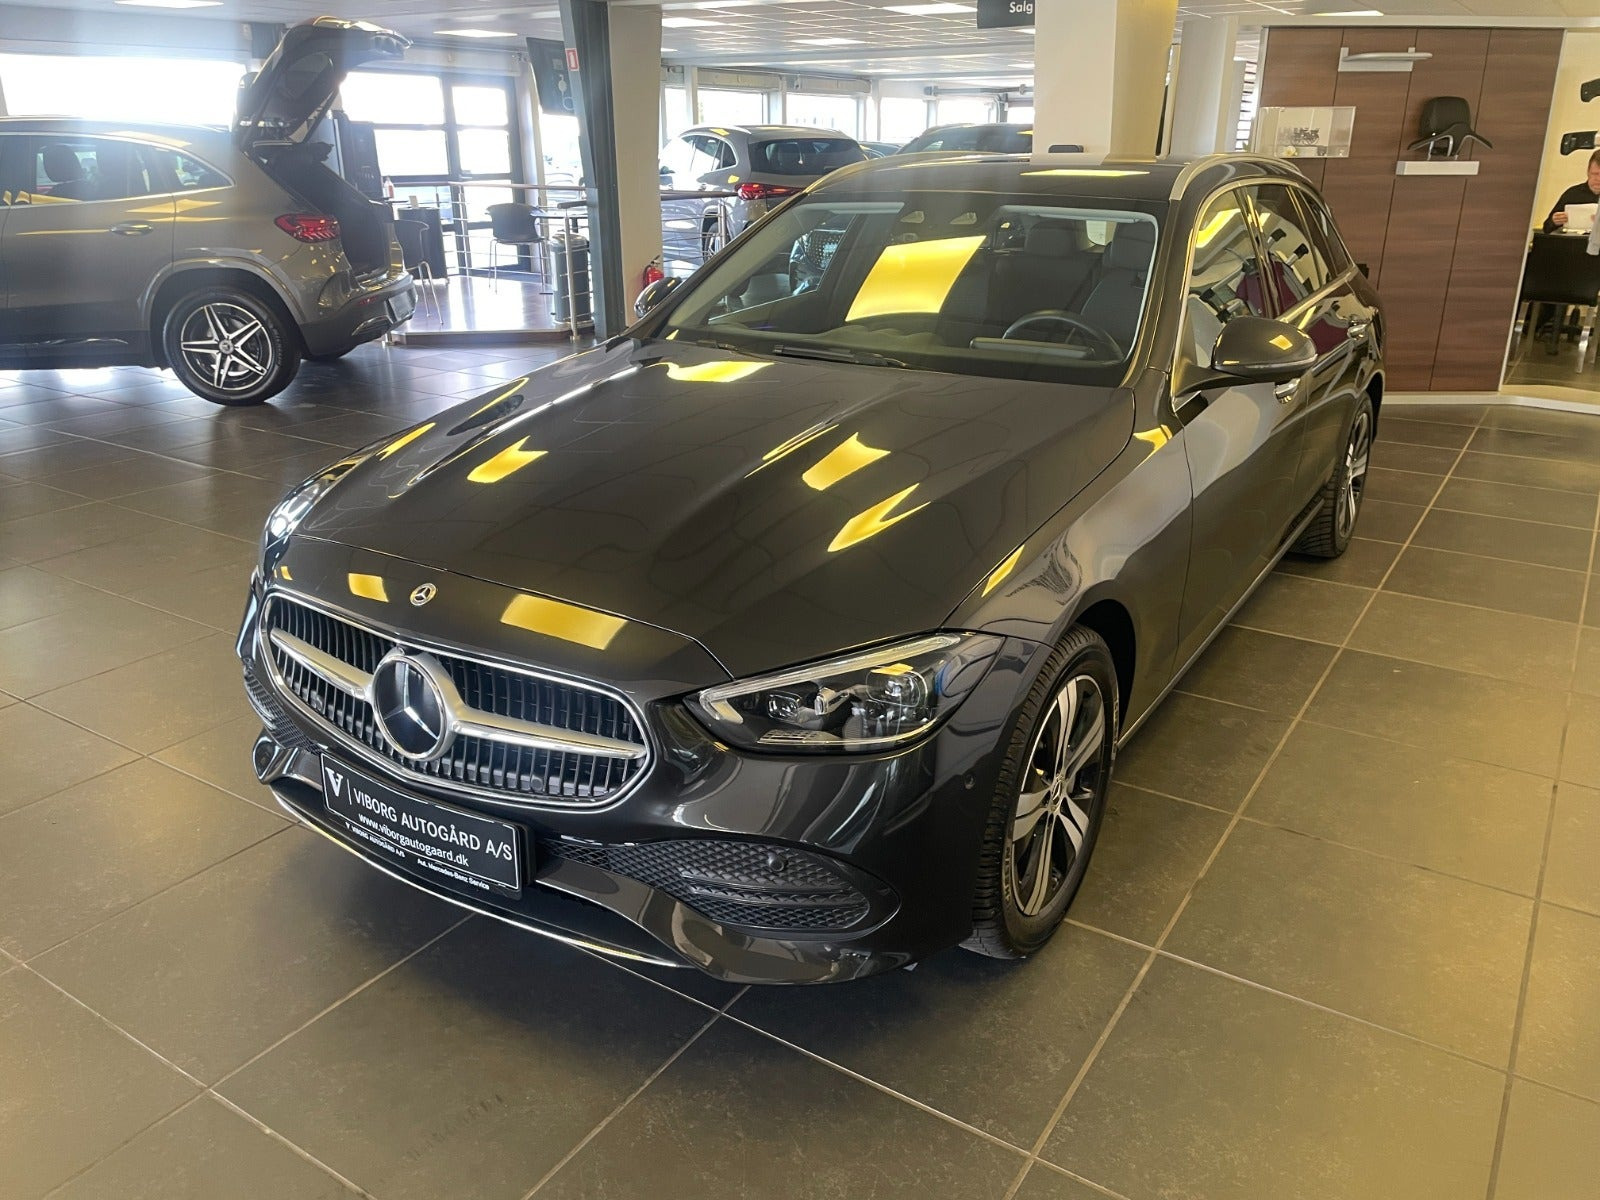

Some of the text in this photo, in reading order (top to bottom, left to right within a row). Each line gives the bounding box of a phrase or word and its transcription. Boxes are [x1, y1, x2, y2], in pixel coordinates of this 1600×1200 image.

[1009, 0, 1033, 14] Salg
[353, 787, 398, 822] VIBORG
[401, 812, 480, 851] AUTOGÅRD
[485, 839, 513, 861] A/S
[358, 813, 469, 867] www.viborgautogaard.dk
